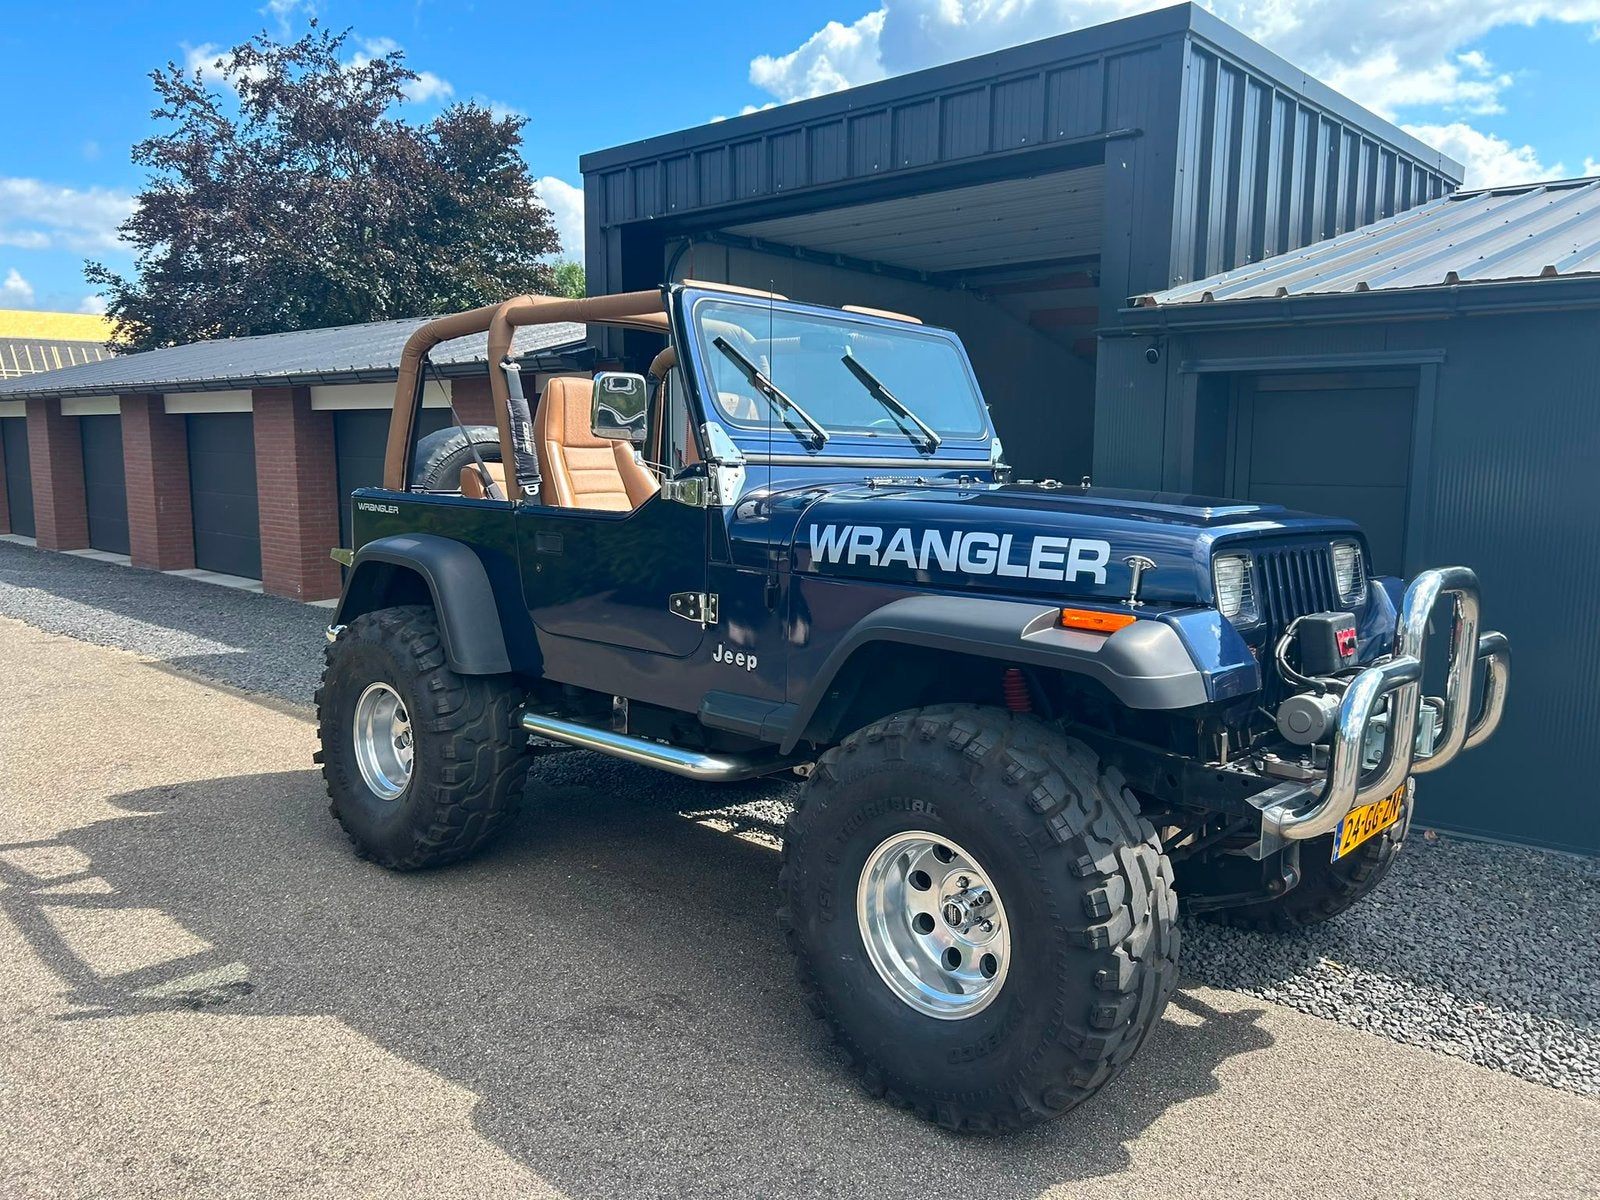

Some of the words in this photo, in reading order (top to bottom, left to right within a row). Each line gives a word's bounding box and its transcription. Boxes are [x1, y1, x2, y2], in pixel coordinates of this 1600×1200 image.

[357, 502, 399, 515] WRANGLER
[809, 523, 1111, 585] WRANGLER
[712, 644, 758, 672] Jeep
